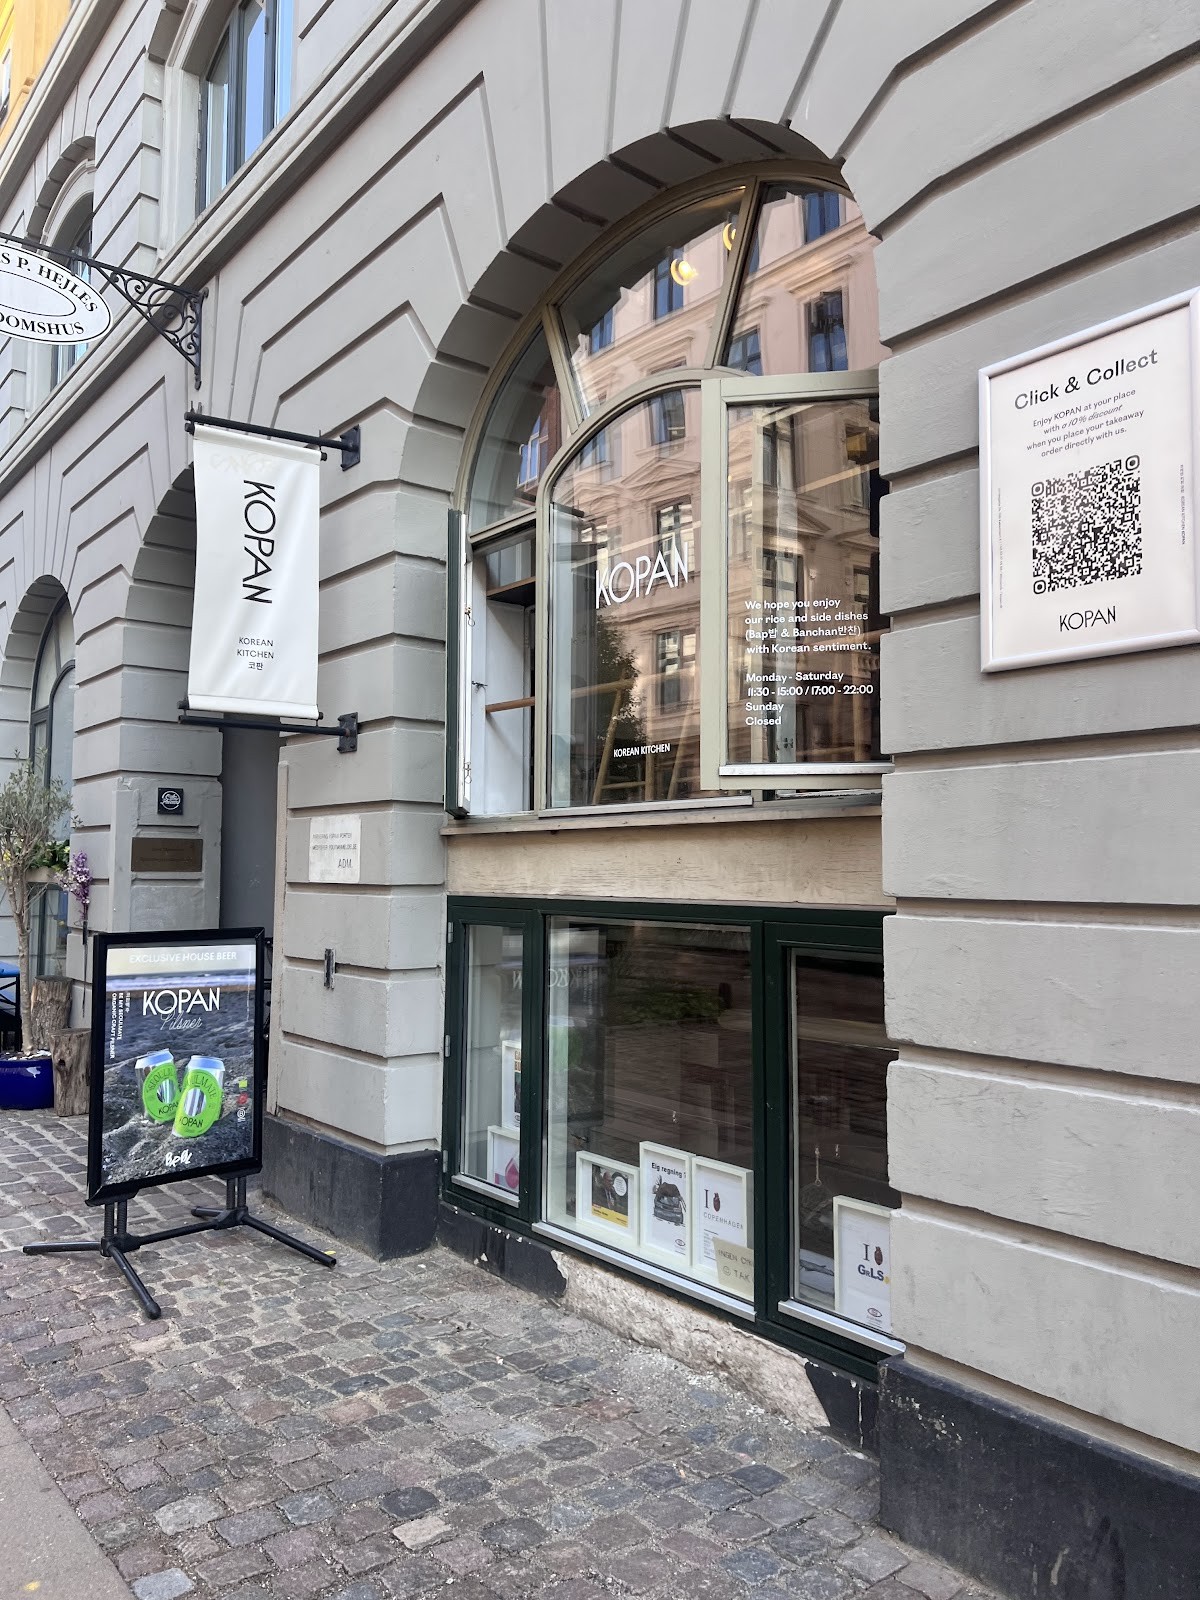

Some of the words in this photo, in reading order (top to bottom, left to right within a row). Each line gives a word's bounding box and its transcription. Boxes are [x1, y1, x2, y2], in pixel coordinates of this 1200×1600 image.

[0, 252, 11, 264] S
[17, 256, 31, 272] P.
[38, 264, 98, 312] HEJLES
[1014, 383, 1060, 410] Click
[1064, 376, 1081, 394] &
[1086, 348, 1158, 386] Collect
[1033, 416, 1052, 428] Enjoy
[1054, 406, 1082, 421] KOPAN
[1084, 404, 1092, 412] at
[1093, 397, 1112, 410] your
[1113, 389, 1136, 404] place
[1044, 424, 1060, 434] with
[1088, 404, 1123, 421] discount
[1026, 440, 1046, 450] when
[1048, 436, 1062, 446] you
[1063, 429, 1084, 442] place
[1086, 422, 1104, 434] your
[1106, 410, 1144, 426] takeaway
[1041, 446, 1062, 458] order
[1064, 436, 1094, 450] directly
[1096, 430, 1113, 441] with
[1115, 427, 1127, 435] us.
[242, 480, 276, 604] KOPAN
[596, 542, 688, 610] KOPAN
[745, 600, 762, 610] We
[764, 600, 790, 612] hope
[792, 600, 810, 610] you
[812, 598, 840, 610] enjoy
[744, 616, 763, 624] our
[765, 614, 786, 624] rice
[788, 613, 808, 622] and
[810, 612, 832, 622] side
[834, 612, 868, 620] dishes
[1060, 606, 1116, 632] KOPAN
[238, 636, 274, 646] KOREAN
[780, 628, 790, 638] &
[236, 648, 274, 659] KITCHEN
[746, 644, 770, 654] with
[772, 644, 810, 653] Korean
[812, 642, 872, 652] sentiment.
[248, 662, 264, 670] 코판
[746, 673, 788, 684] Monday
[795, 671, 844, 682] Saturday
[748, 687, 770, 696] 11:30
[778, 686, 803, 696] 15:00
[804, 686, 810, 696] /
[811, 686, 836, 696] 17:00
[842, 684, 874, 694] 22:00
[746, 702, 784, 712] Sunday
[746, 716, 782, 726] Closed
[614, 746, 640, 758] KOREAN
[640, 742, 670, 754] KITCHEN
[128, 952, 180, 964] EXCLUSIVE
[182, 952, 215, 962] HOUSE
[216, 950, 237, 960] BEER
[142, 986, 220, 1016] KOPAN
[160, 1006, 203, 1030] Pilsner
[180, 1116, 204, 1128] OPAN
[662, 1166, 682, 1178] regning
[704, 1188, 710, 1209] I
[704, 1212, 744, 1230] COPENHAGEN
[863, 1243, 870, 1262] I
